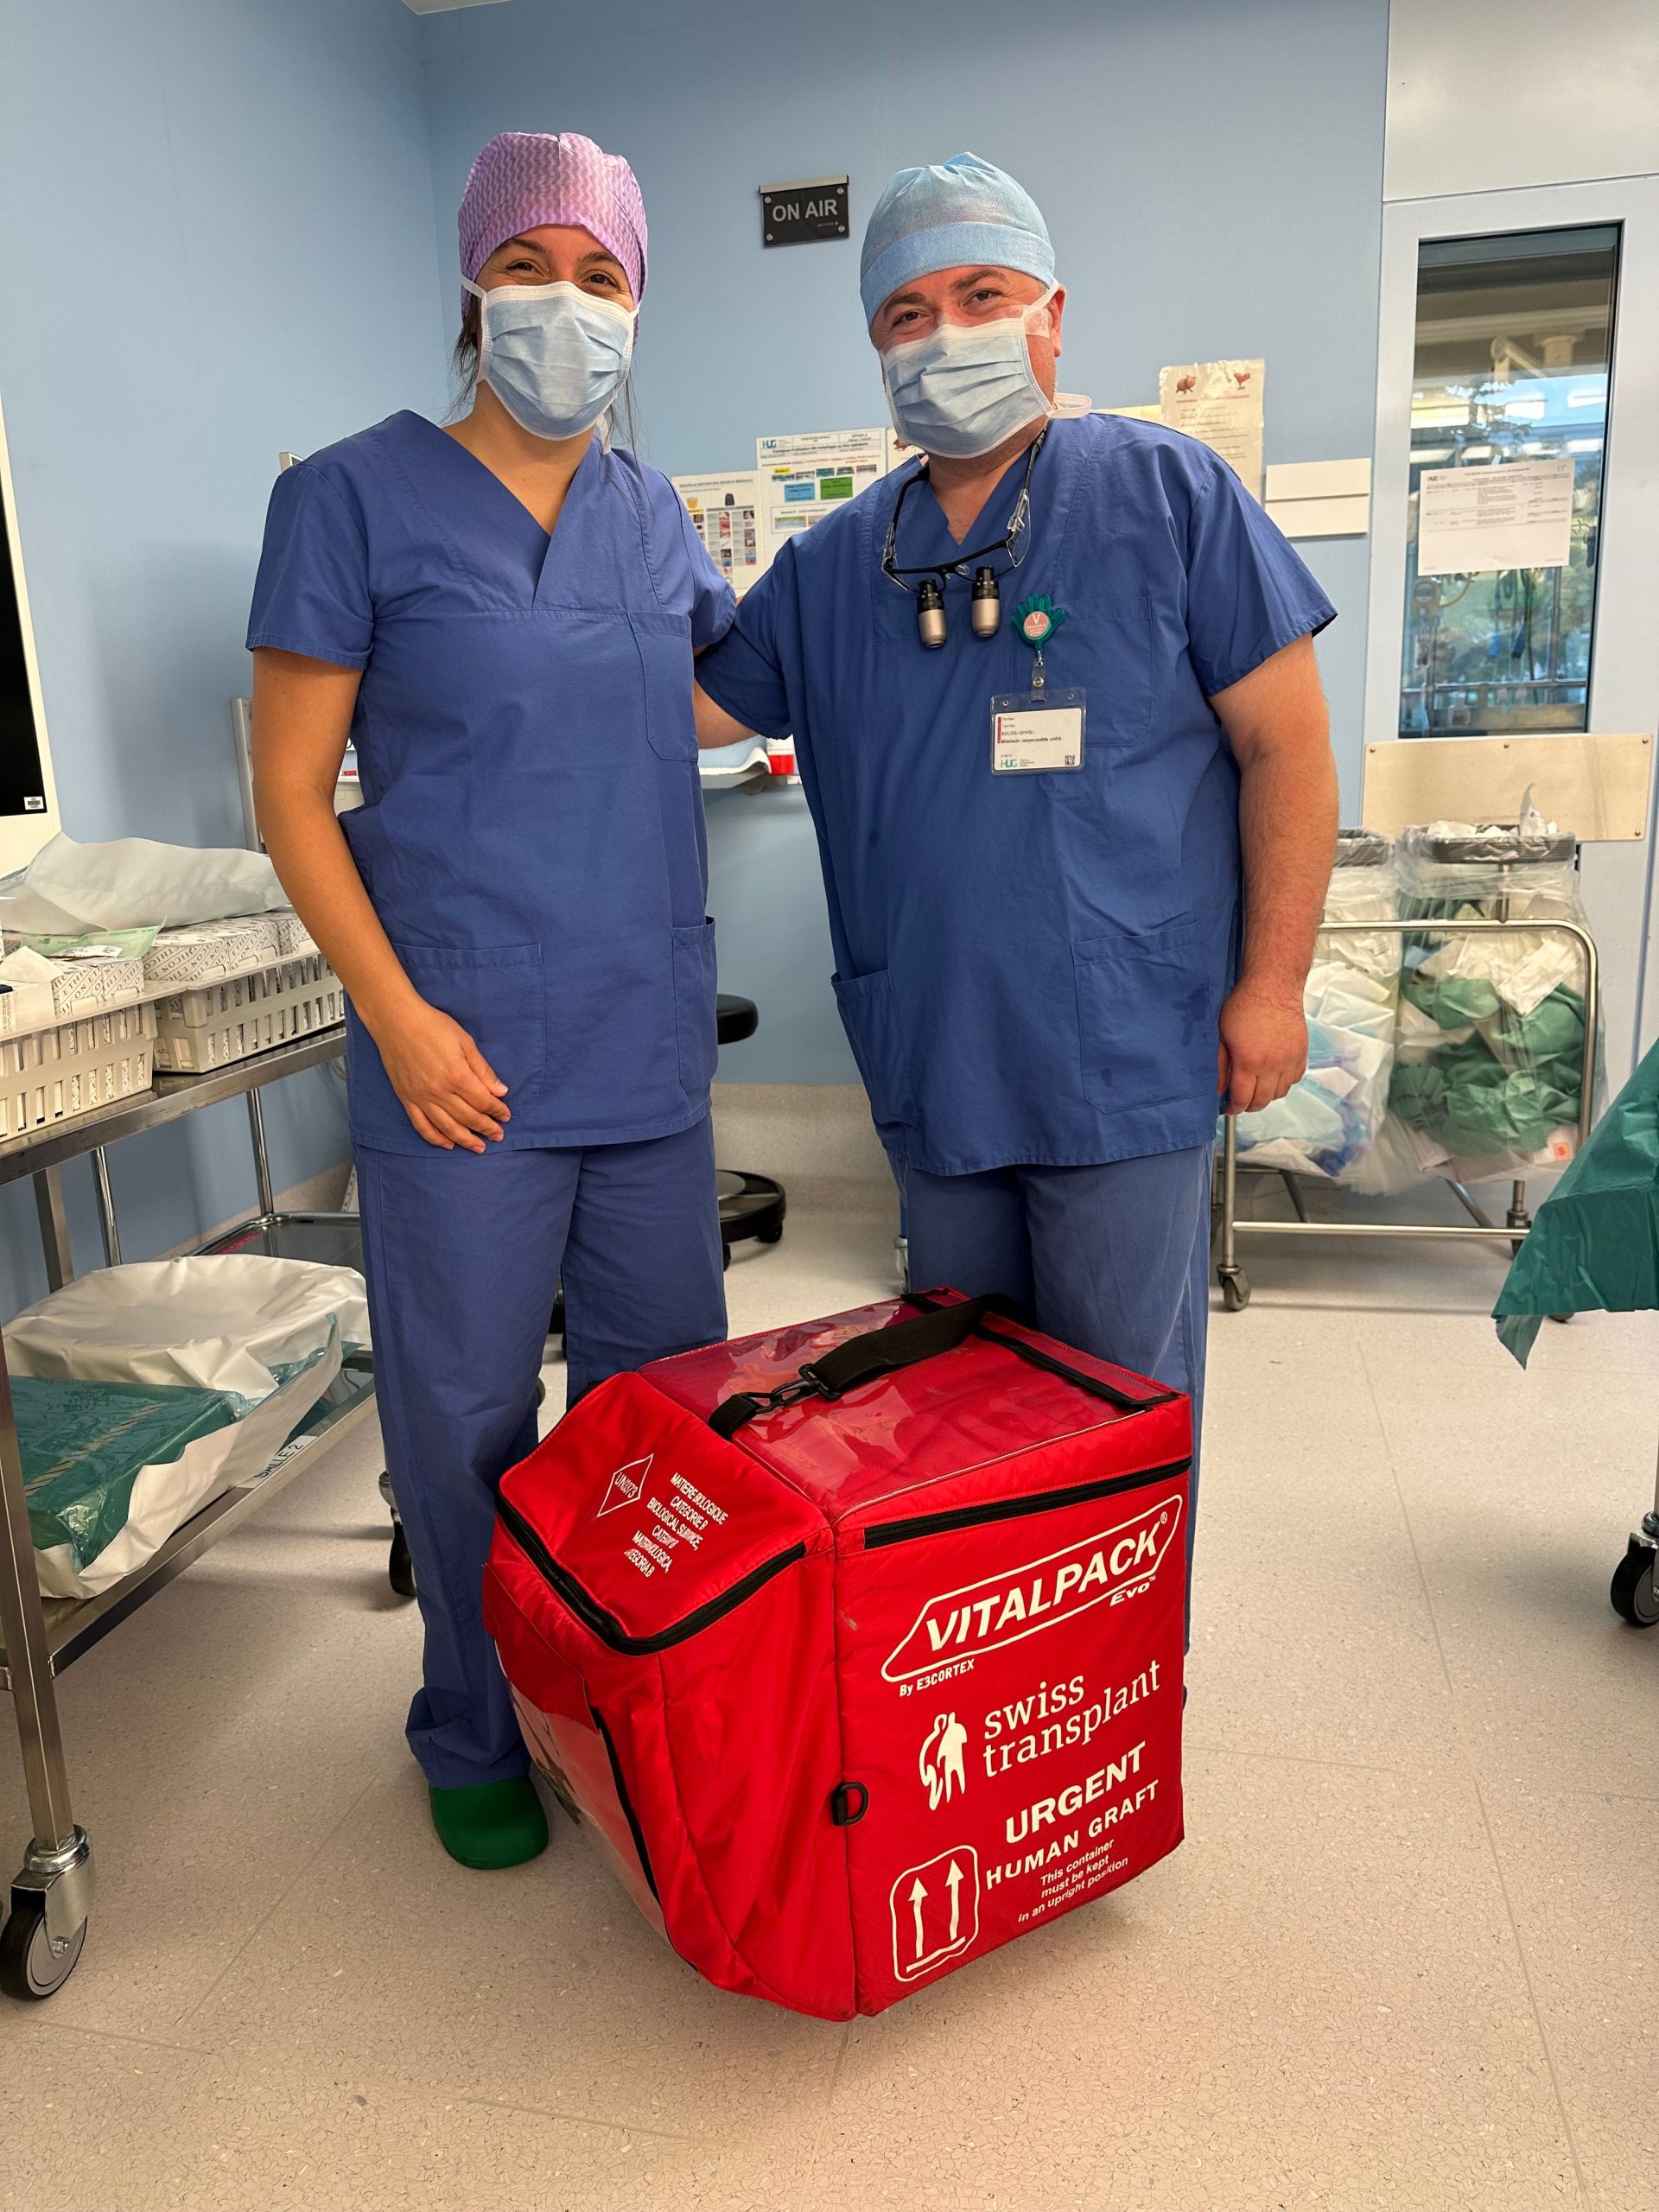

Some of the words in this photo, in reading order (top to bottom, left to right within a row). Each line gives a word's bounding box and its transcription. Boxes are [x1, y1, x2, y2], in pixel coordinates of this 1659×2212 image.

[772, 203, 800, 222] ON
[805, 199, 838, 219] AIR
[1033, 613, 1040, 624] V
[614, 1471, 638, 1498] UN3373
[670, 1471, 699, 1500] MATIERE
[646, 1497, 680, 1532] BIOLOGICAL
[670, 1496, 705, 1529] CATEGORIE
[698, 1520, 709, 1530] B
[899, 1684, 913, 1697] By
[916, 1658, 976, 1691] E3CORTEX
[983, 1659, 1160, 1778] transplant
[984, 1675, 1084, 1740] swiss
[1006, 1740, 1146, 1845] URGENT
[986, 1829, 1079, 1891] HUMAN
[1088, 1779, 1159, 1839] GRAFT
[1039, 1867, 1064, 1887] This
[1066, 1839, 1115, 1873] container
[1040, 1880, 1070, 1899] must
[1071, 1870, 1084, 1885] be
[1086, 1854, 1109, 1874] kept
[1018, 1911, 1029, 1923] in
[1032, 1904, 1046, 1917] an
[1047, 1882, 1085, 1909] upright
[1087, 1857, 1128, 1889] position
